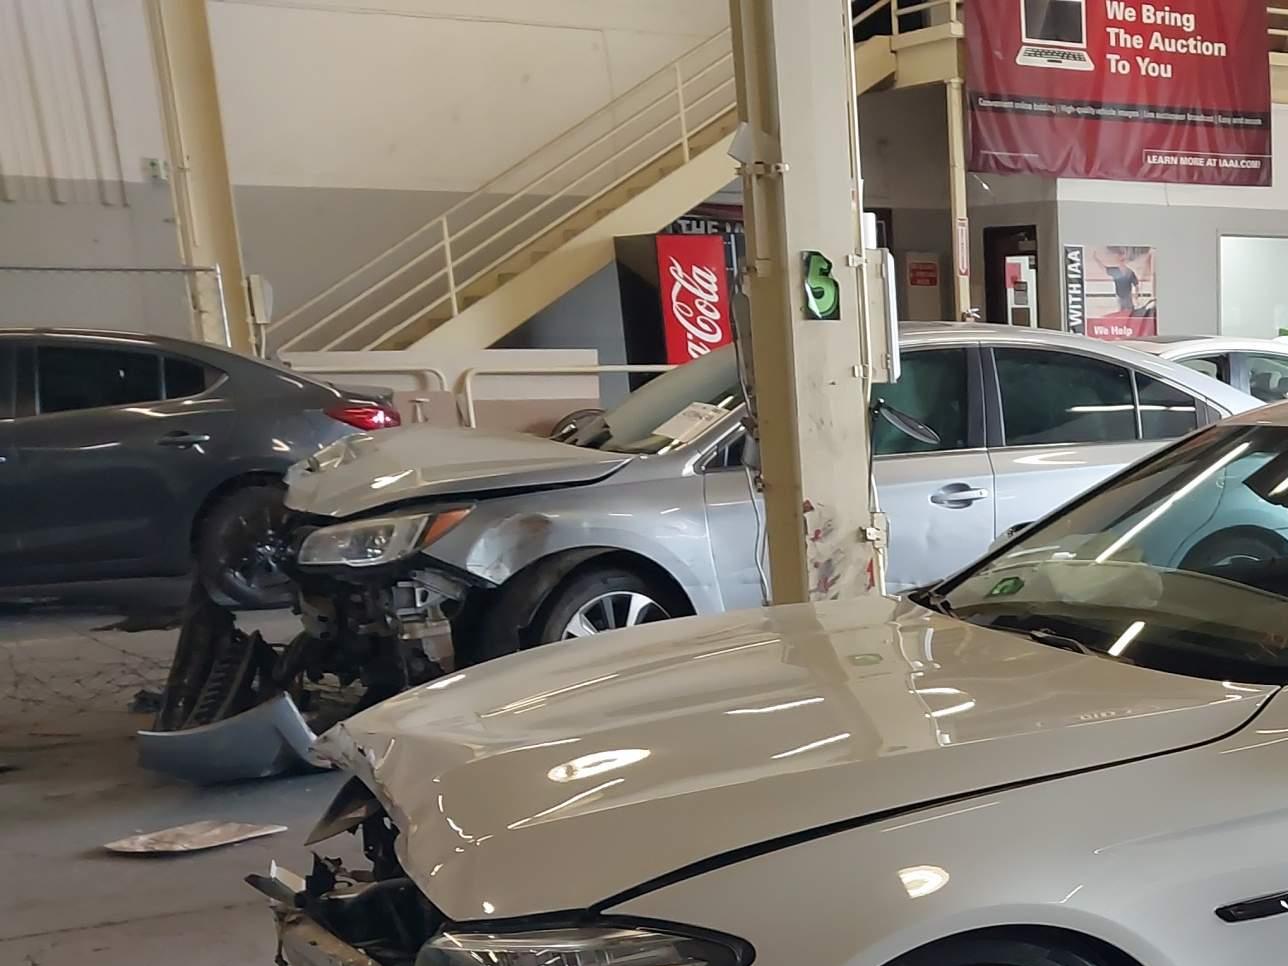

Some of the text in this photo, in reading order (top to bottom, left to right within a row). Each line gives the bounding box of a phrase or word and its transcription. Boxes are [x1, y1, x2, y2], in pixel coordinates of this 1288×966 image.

[1106, 0, 1195, 32] We Bring
[1106, 27, 1227, 56] The Auction
[1106, 54, 1172, 78] To You
[1147, 154, 1179, 165] LEARN
[1179, 156, 1205, 167] MORE
[1205, 158, 1218, 168] AT
[1067, 250, 1082, 279] IAA
[1067, 283, 1083, 327] WITH
[1093, 325, 1110, 336] We
[1110, 325, 1133, 337] Help
